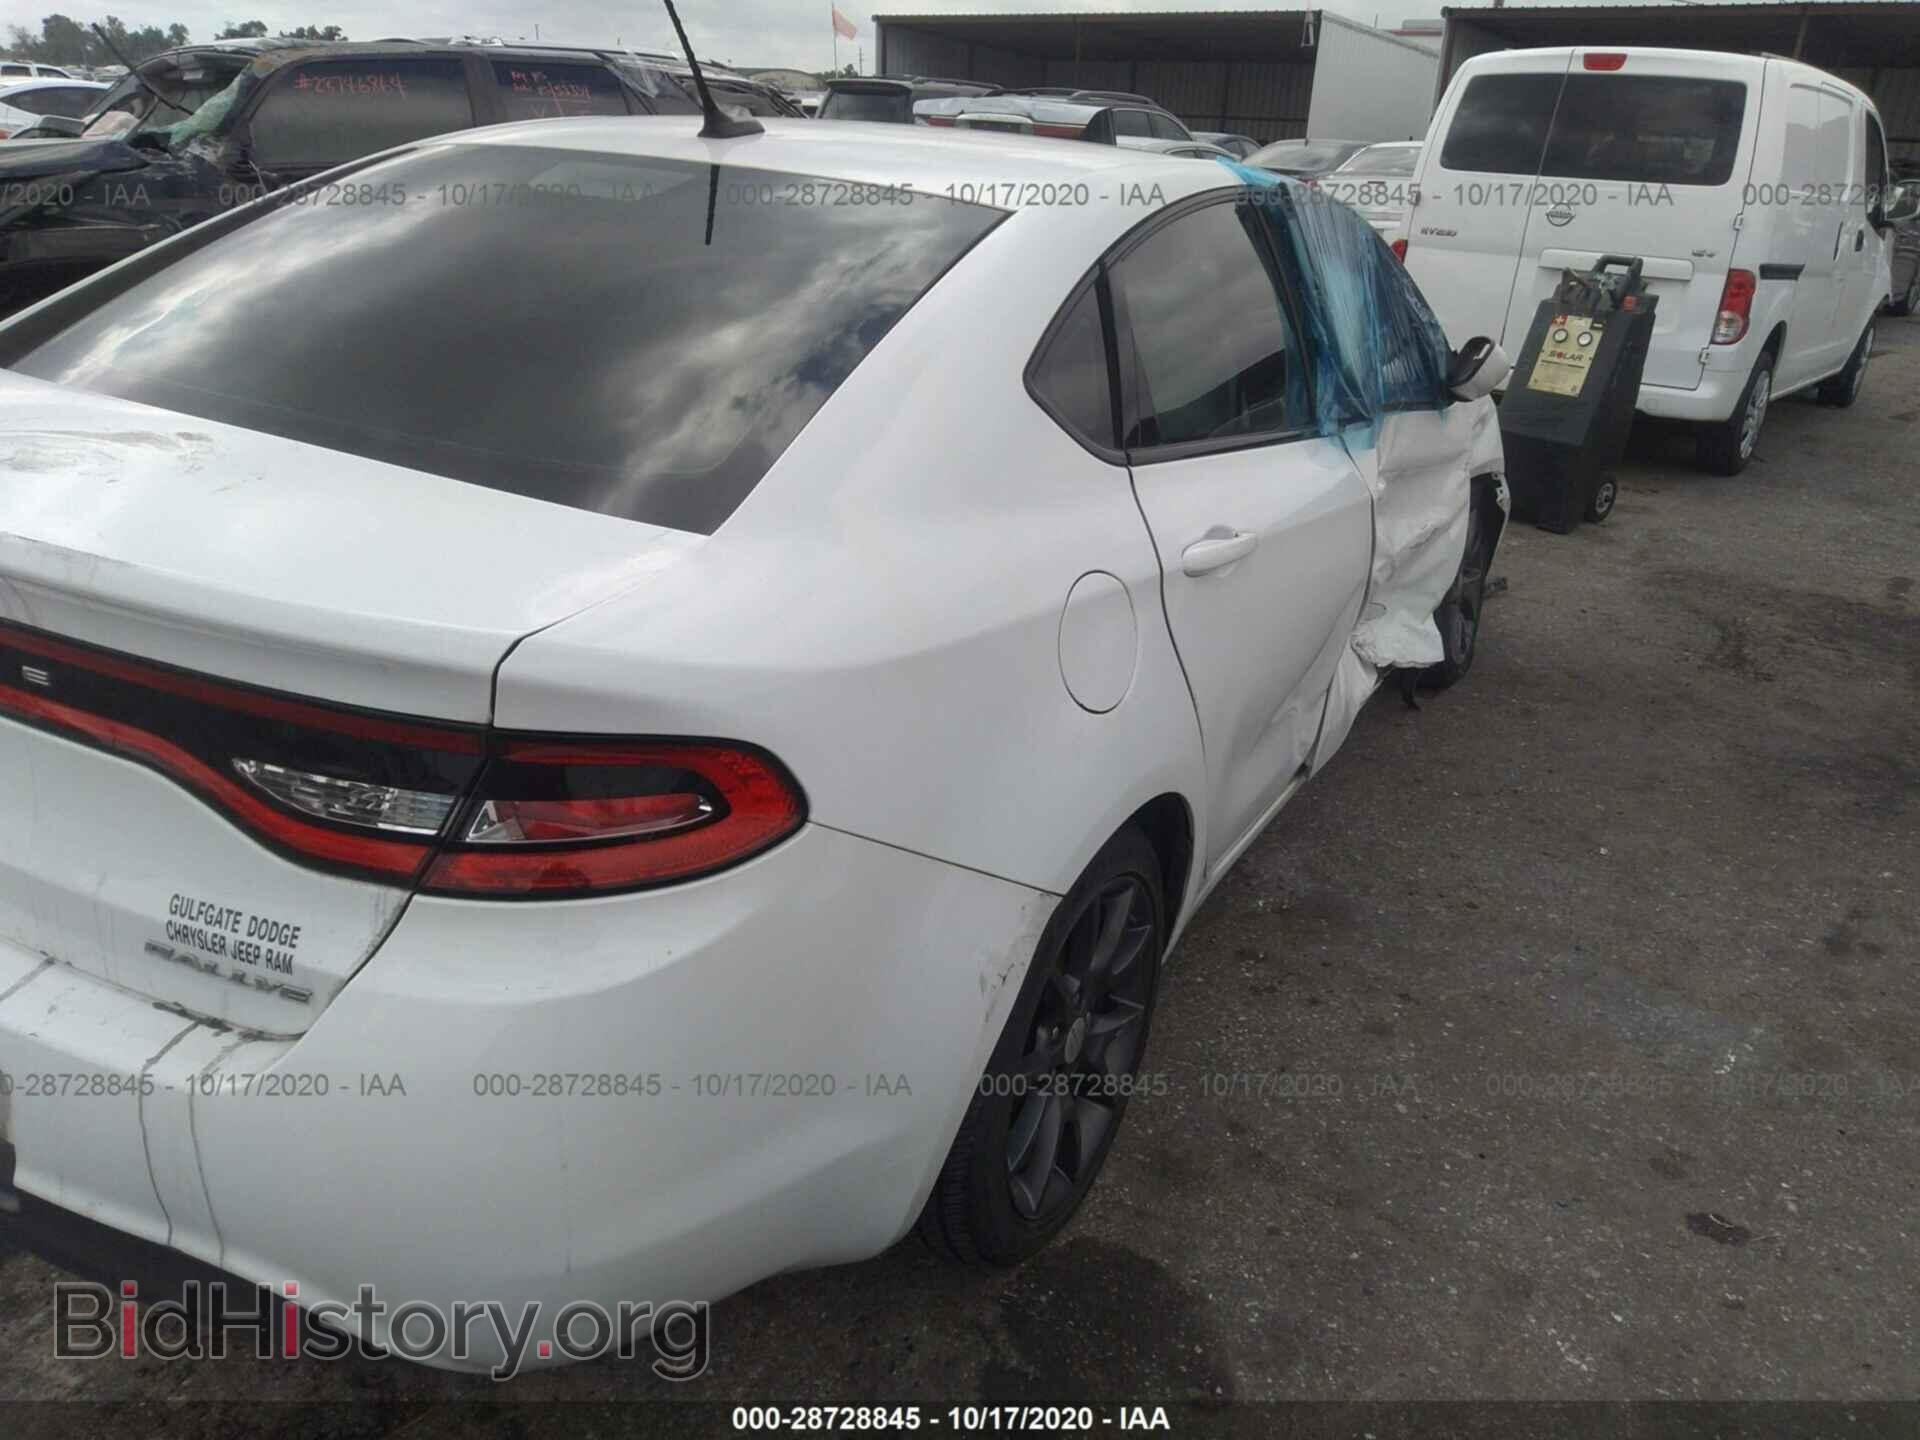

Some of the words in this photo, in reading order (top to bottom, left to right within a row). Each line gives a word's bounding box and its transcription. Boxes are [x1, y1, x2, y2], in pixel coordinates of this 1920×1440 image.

[165, 919, 227, 957] CHRYSLER
[230, 940, 261, 966] JEEP
[265, 948, 294, 975] RAM
[169, 893, 243, 934] GULFGATE
[246, 915, 302, 949] DODGE
